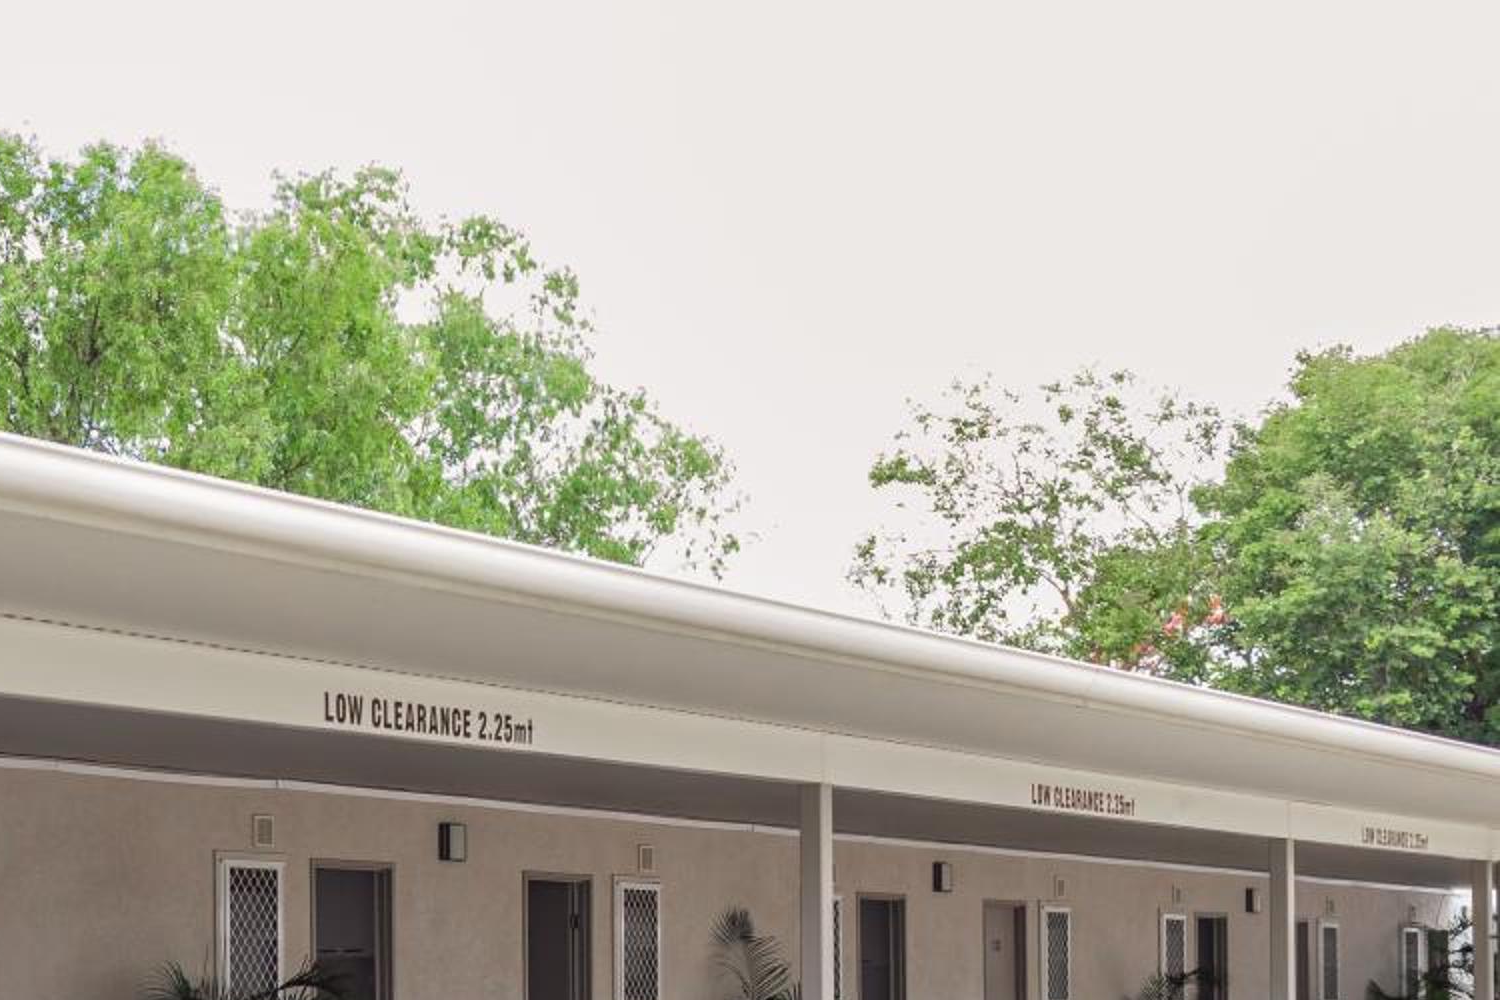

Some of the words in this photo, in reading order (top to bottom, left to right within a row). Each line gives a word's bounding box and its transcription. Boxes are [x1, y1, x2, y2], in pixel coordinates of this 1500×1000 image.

[324, 691, 363, 725] LOW
[372, 698, 471, 738] CLEARANCE
[478, 711, 533, 744] 2.25mt
[1032, 784, 1050, 806] LOW
